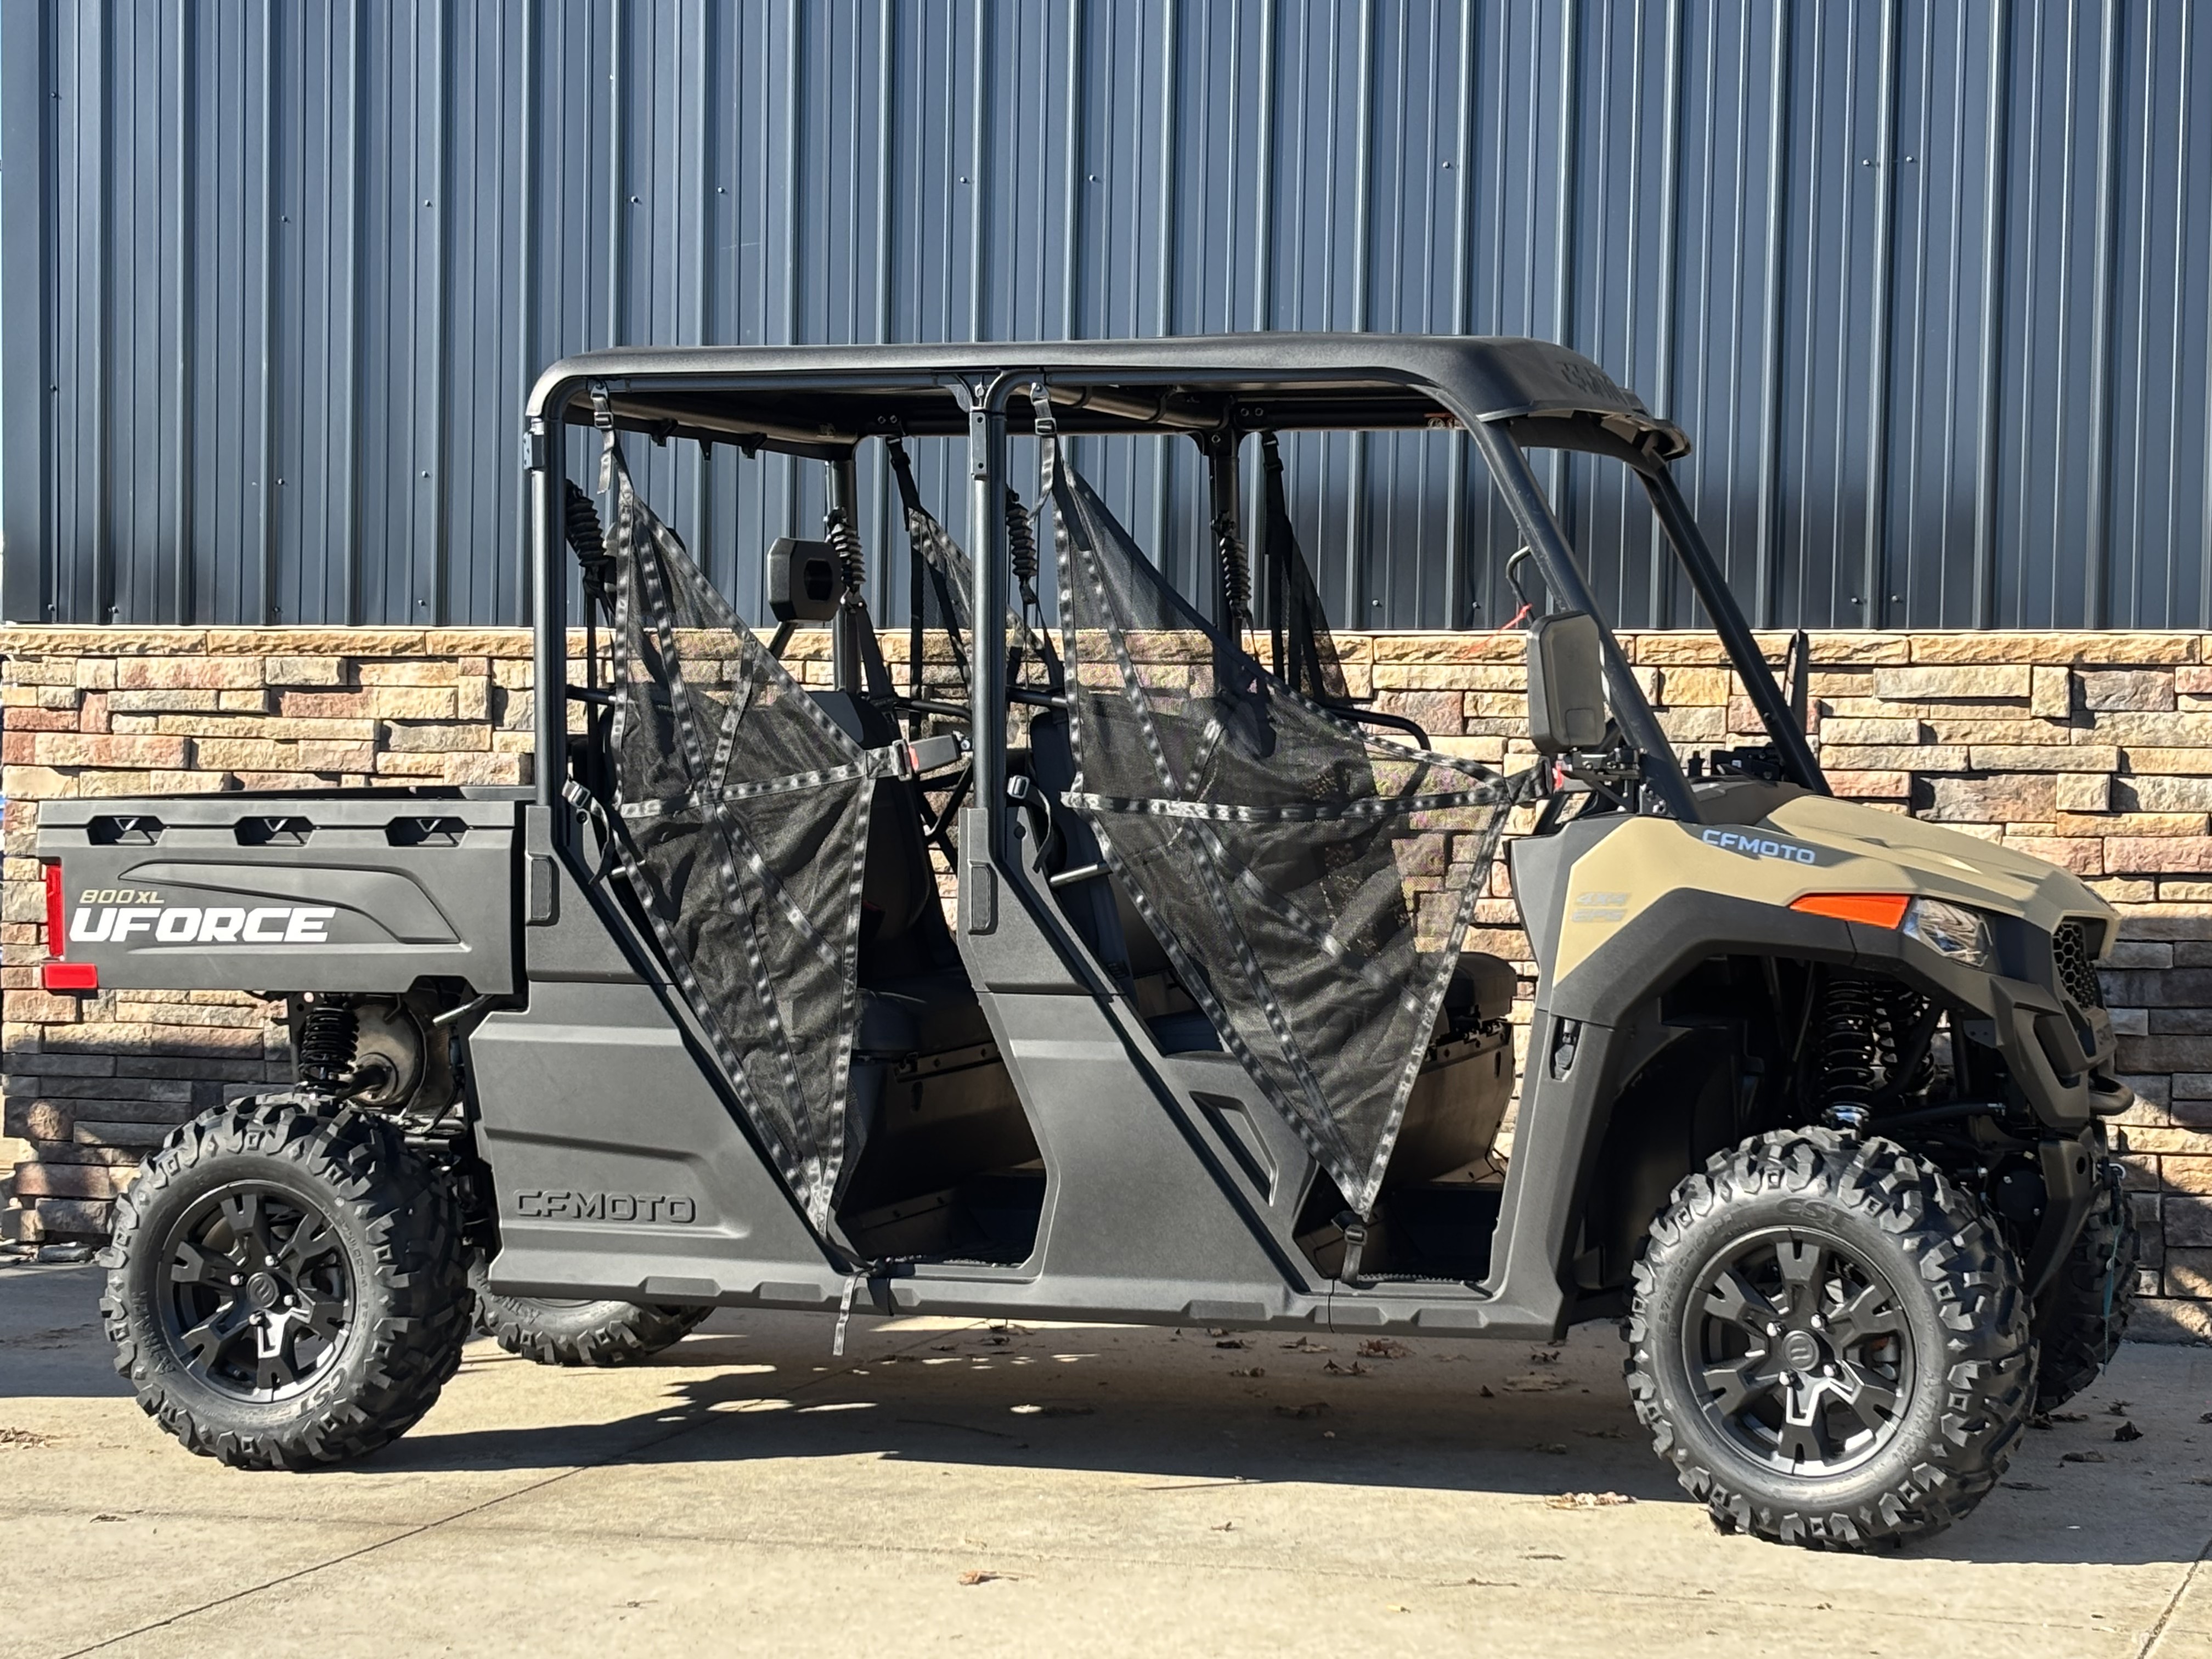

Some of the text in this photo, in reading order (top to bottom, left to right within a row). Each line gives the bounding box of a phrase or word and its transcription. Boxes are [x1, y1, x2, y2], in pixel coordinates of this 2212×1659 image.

[1702, 829, 1815, 864] CFMOTO
[80, 889, 165, 904] 800XL
[69, 907, 336, 942] UFORCE
[514, 1189, 696, 1224] CFMOTO
[1776, 1197, 1856, 1228] CST
[296, 1367, 348, 1420] CST
